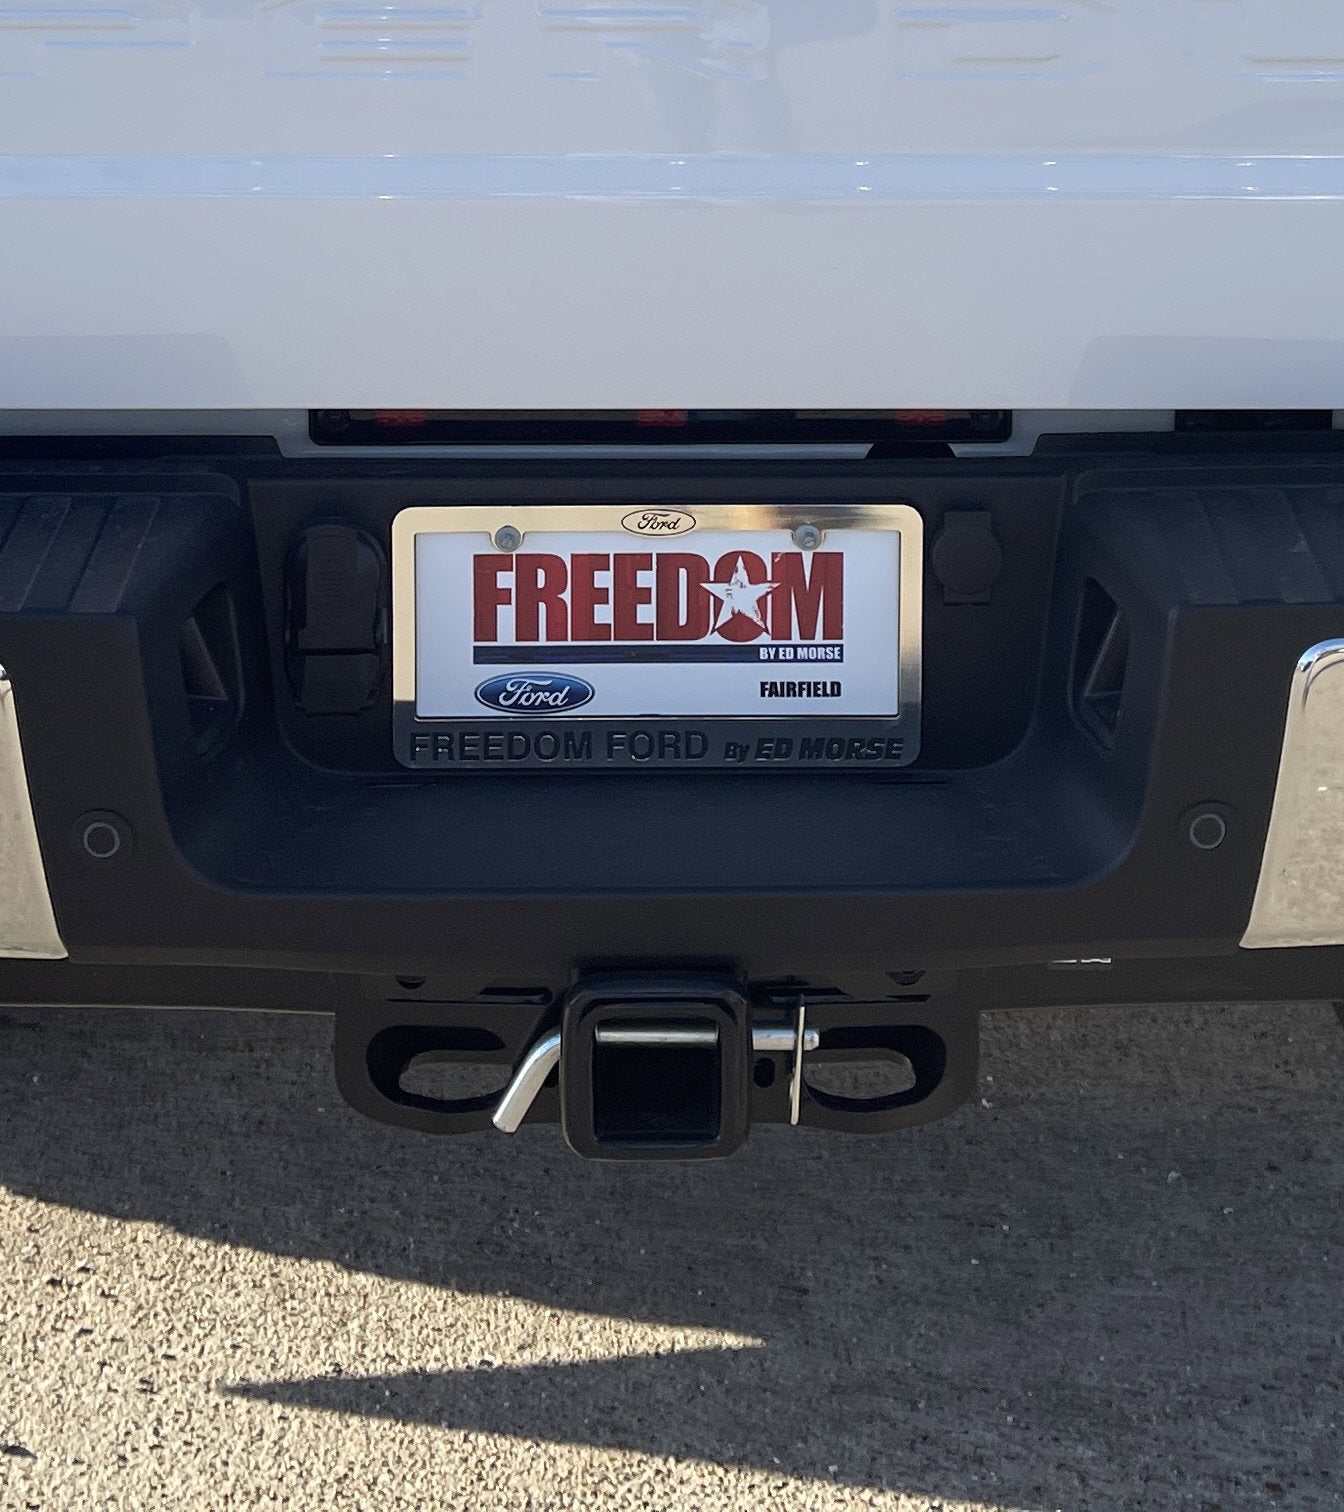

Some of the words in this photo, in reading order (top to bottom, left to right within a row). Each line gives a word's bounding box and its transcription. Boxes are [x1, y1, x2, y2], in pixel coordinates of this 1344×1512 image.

[637, 511, 680, 532] Ford
[473, 550, 844, 642] FREEDOM
[759, 647, 776, 660] BY
[778, 647, 794, 660] ED
[797, 647, 841, 660] MORSE
[498, 672, 569, 706] Ford
[760, 681, 842, 698] FAIRFIELD
[409, 731, 593, 761] FREEDOM
[606, 730, 709, 761] FORD
[755, 737, 799, 761] ED
[799, 737, 904, 761] MORSE
